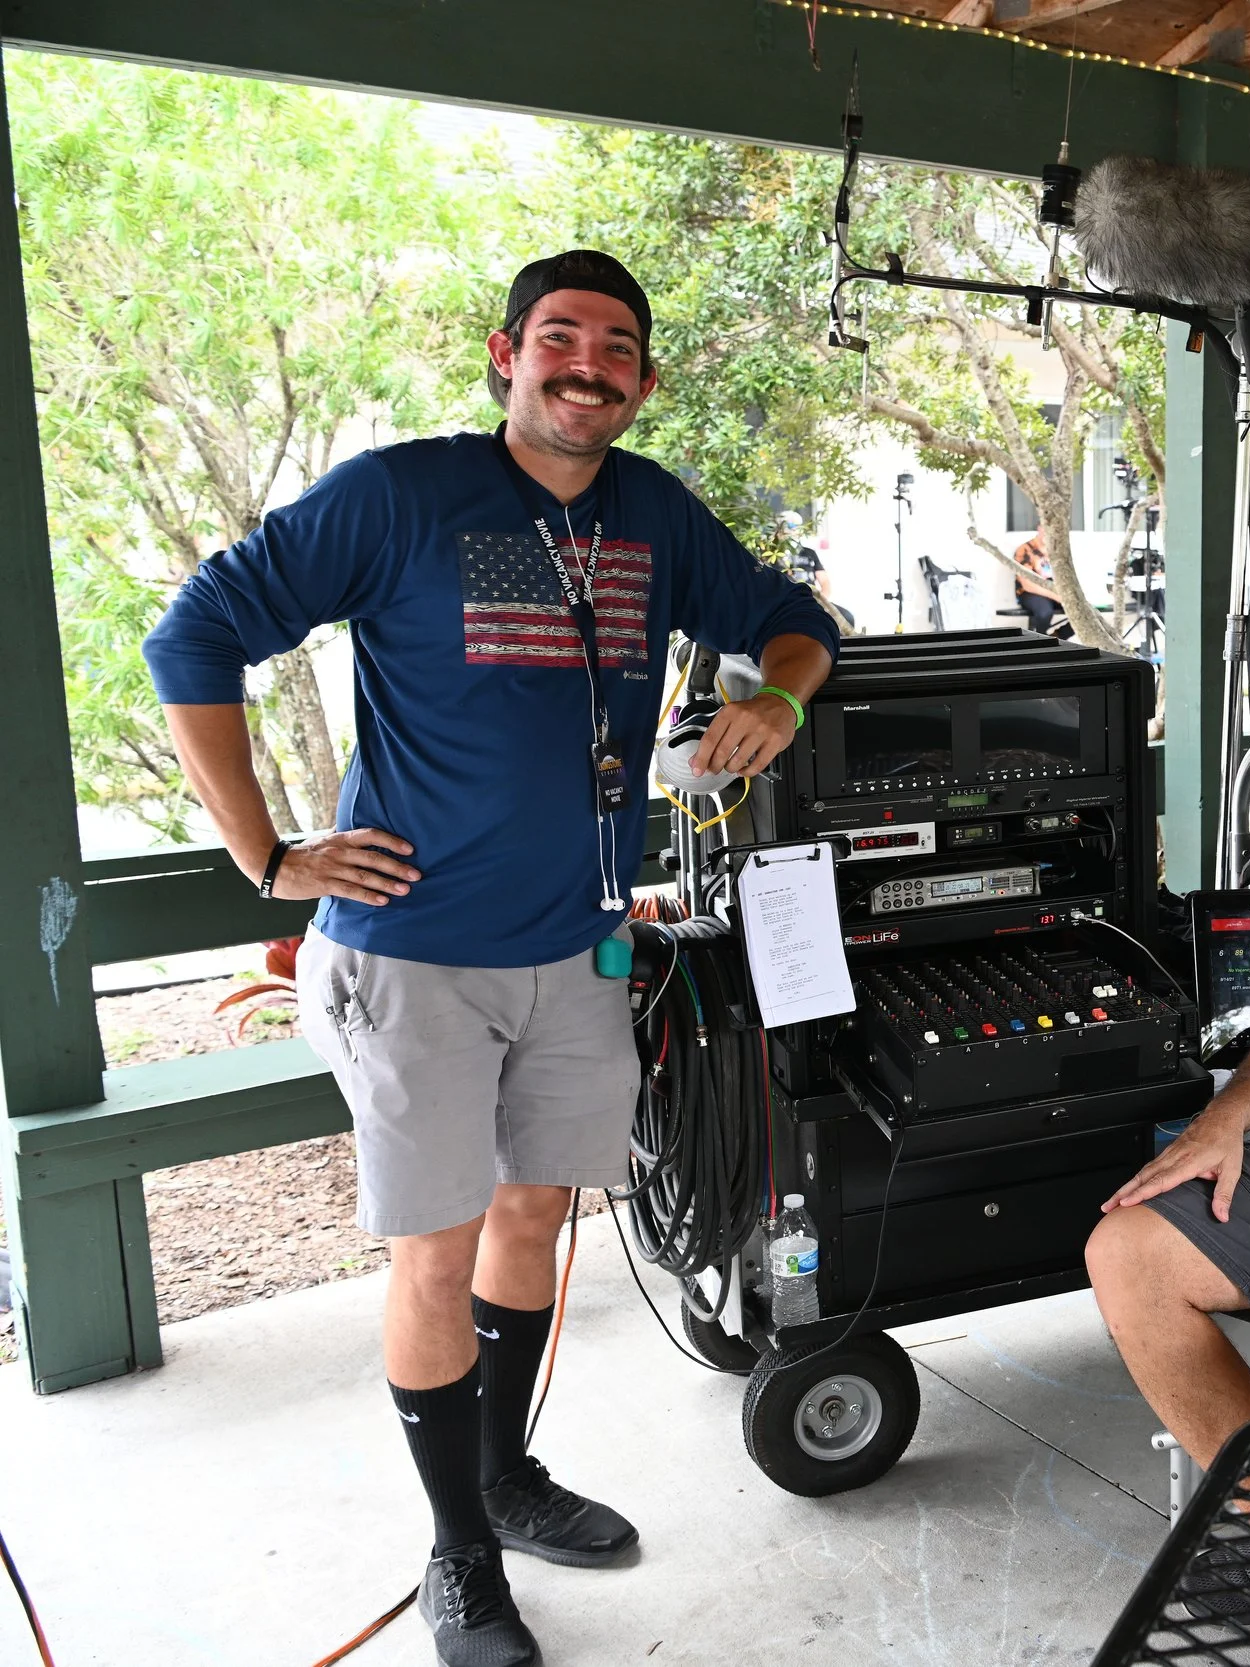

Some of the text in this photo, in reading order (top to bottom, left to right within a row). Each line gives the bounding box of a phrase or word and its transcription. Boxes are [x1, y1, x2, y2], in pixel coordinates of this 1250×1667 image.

[594, 521, 603, 535] NO
[534, 518, 579, 606] NO VACANCY MOVIE
[587, 535, 601, 576] VACANCY
[845, 932, 899, 943] EON LiFe
